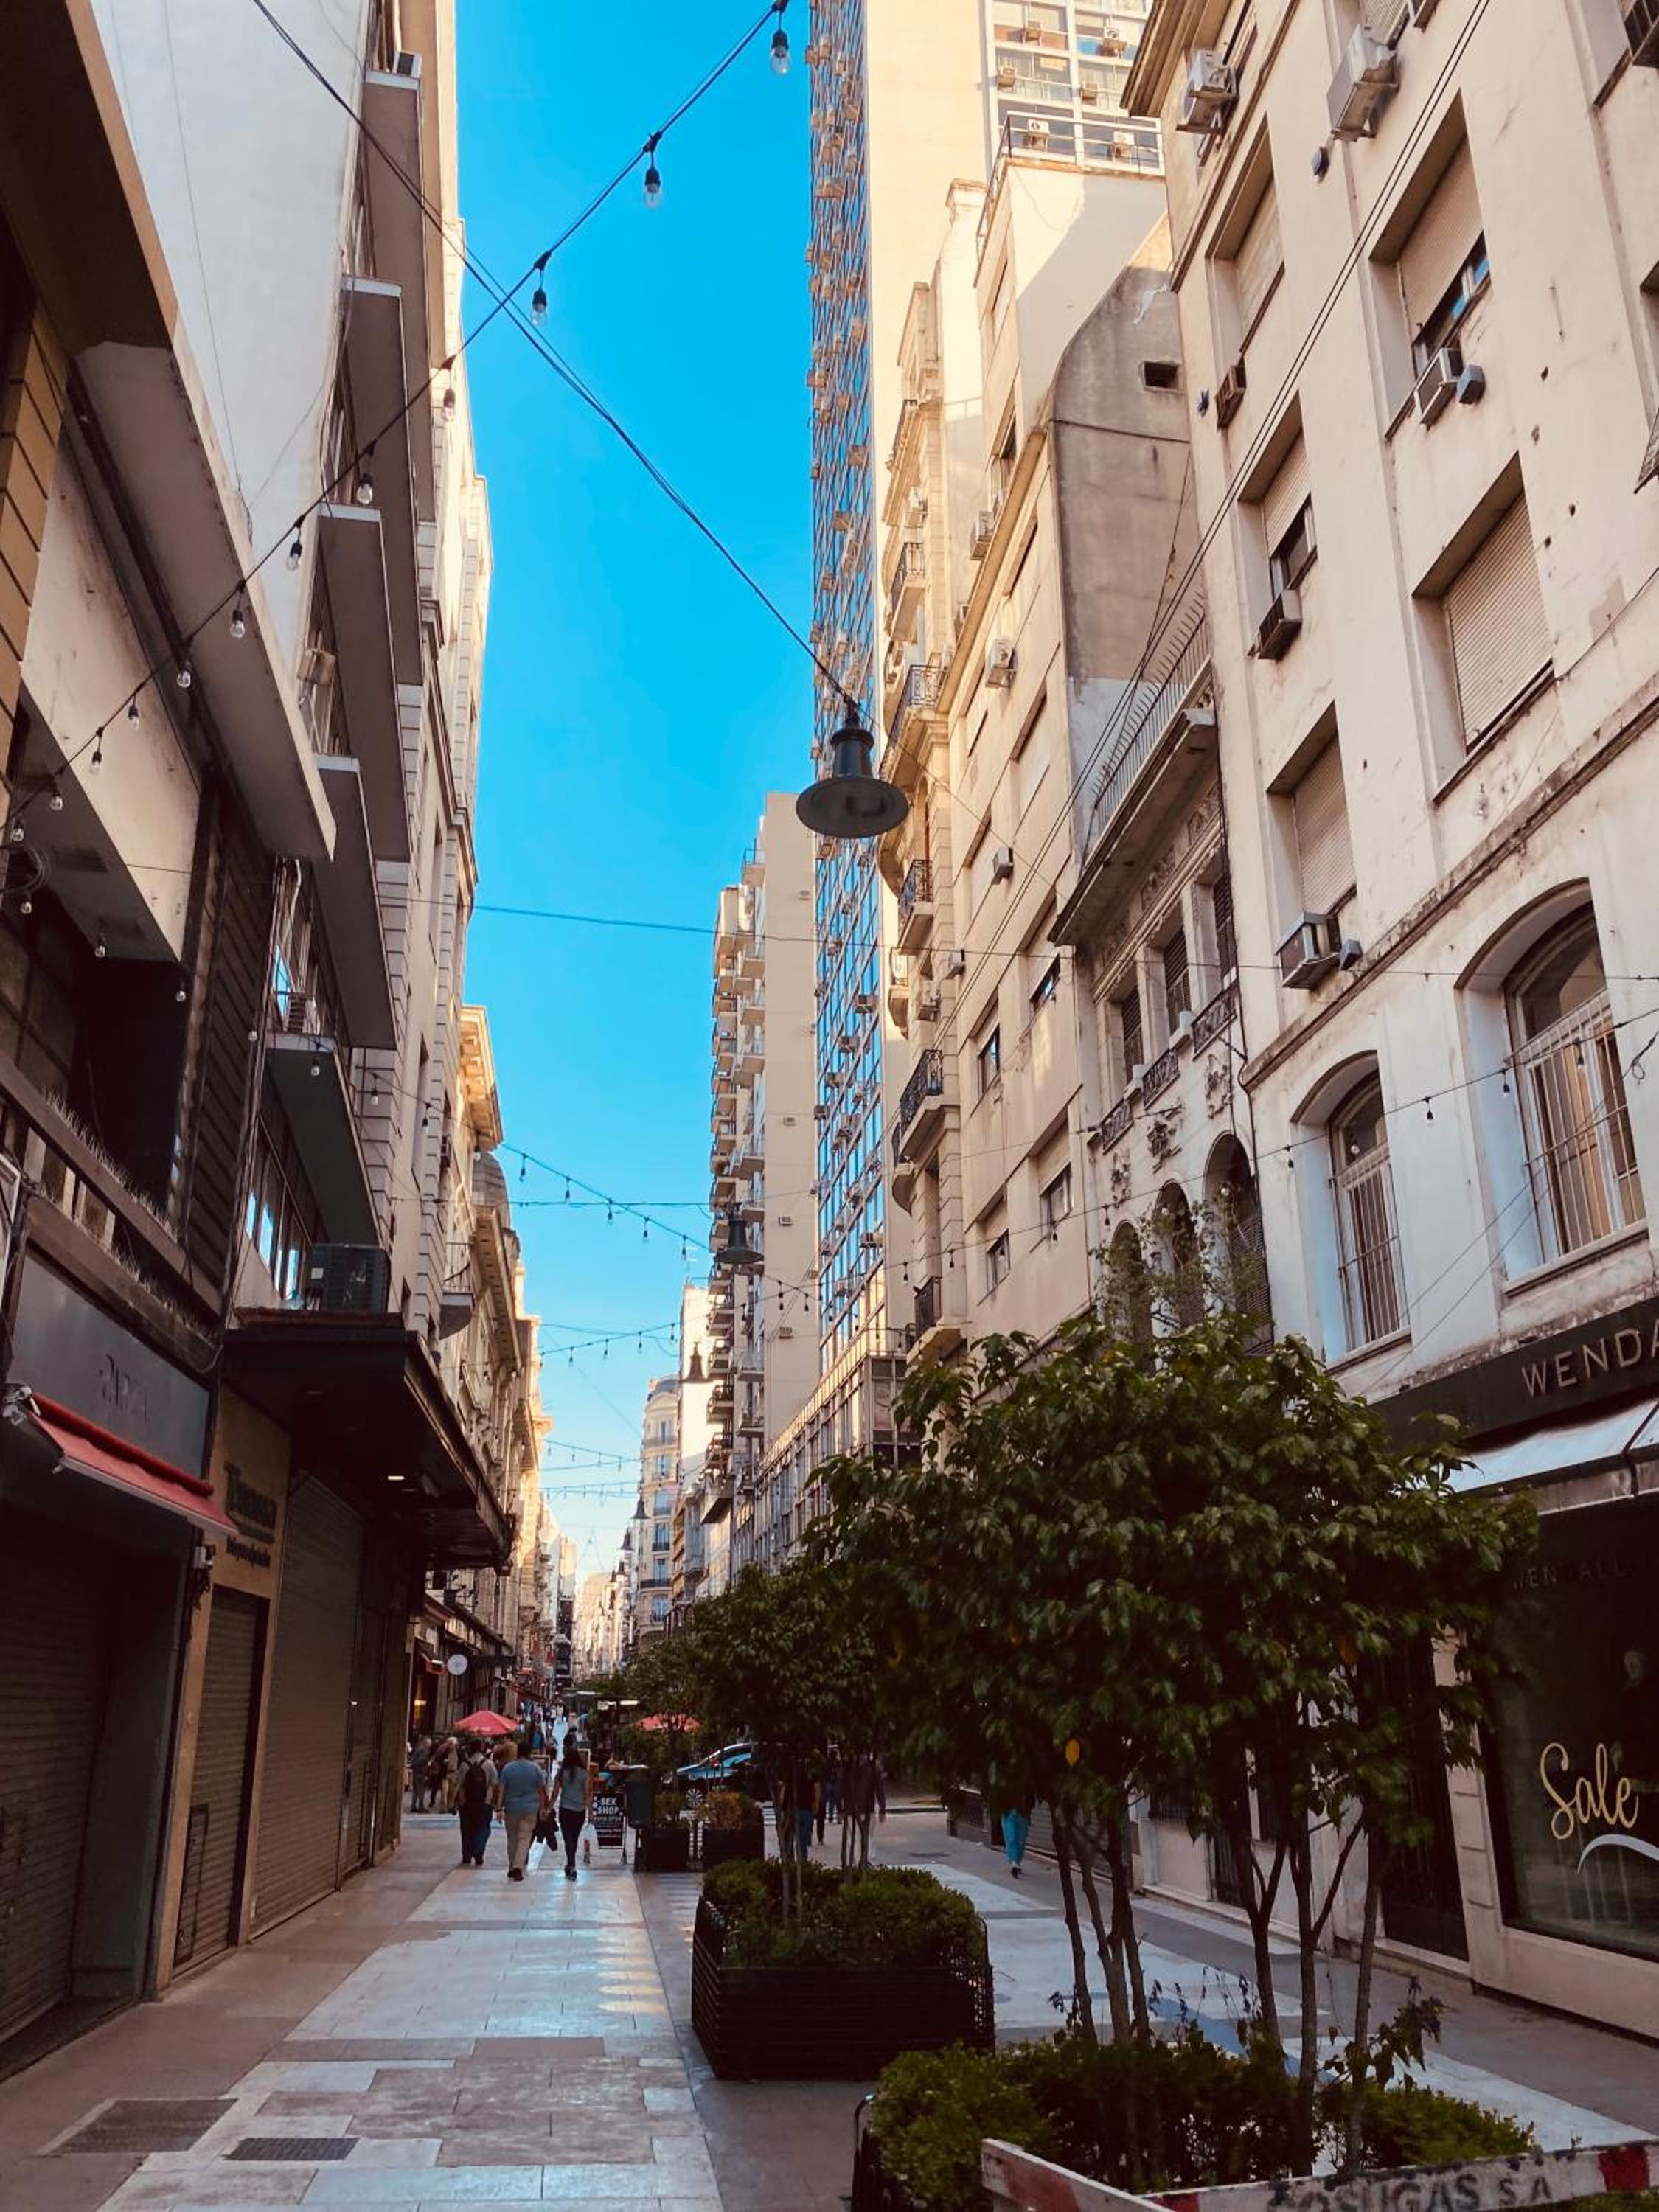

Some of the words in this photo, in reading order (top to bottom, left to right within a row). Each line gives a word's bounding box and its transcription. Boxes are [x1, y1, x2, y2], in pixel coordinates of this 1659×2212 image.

[1540, 1742, 1639, 1840] Sale
[601, 1797, 618, 1806] SEX
[597, 1806, 620, 1815] SHOP
